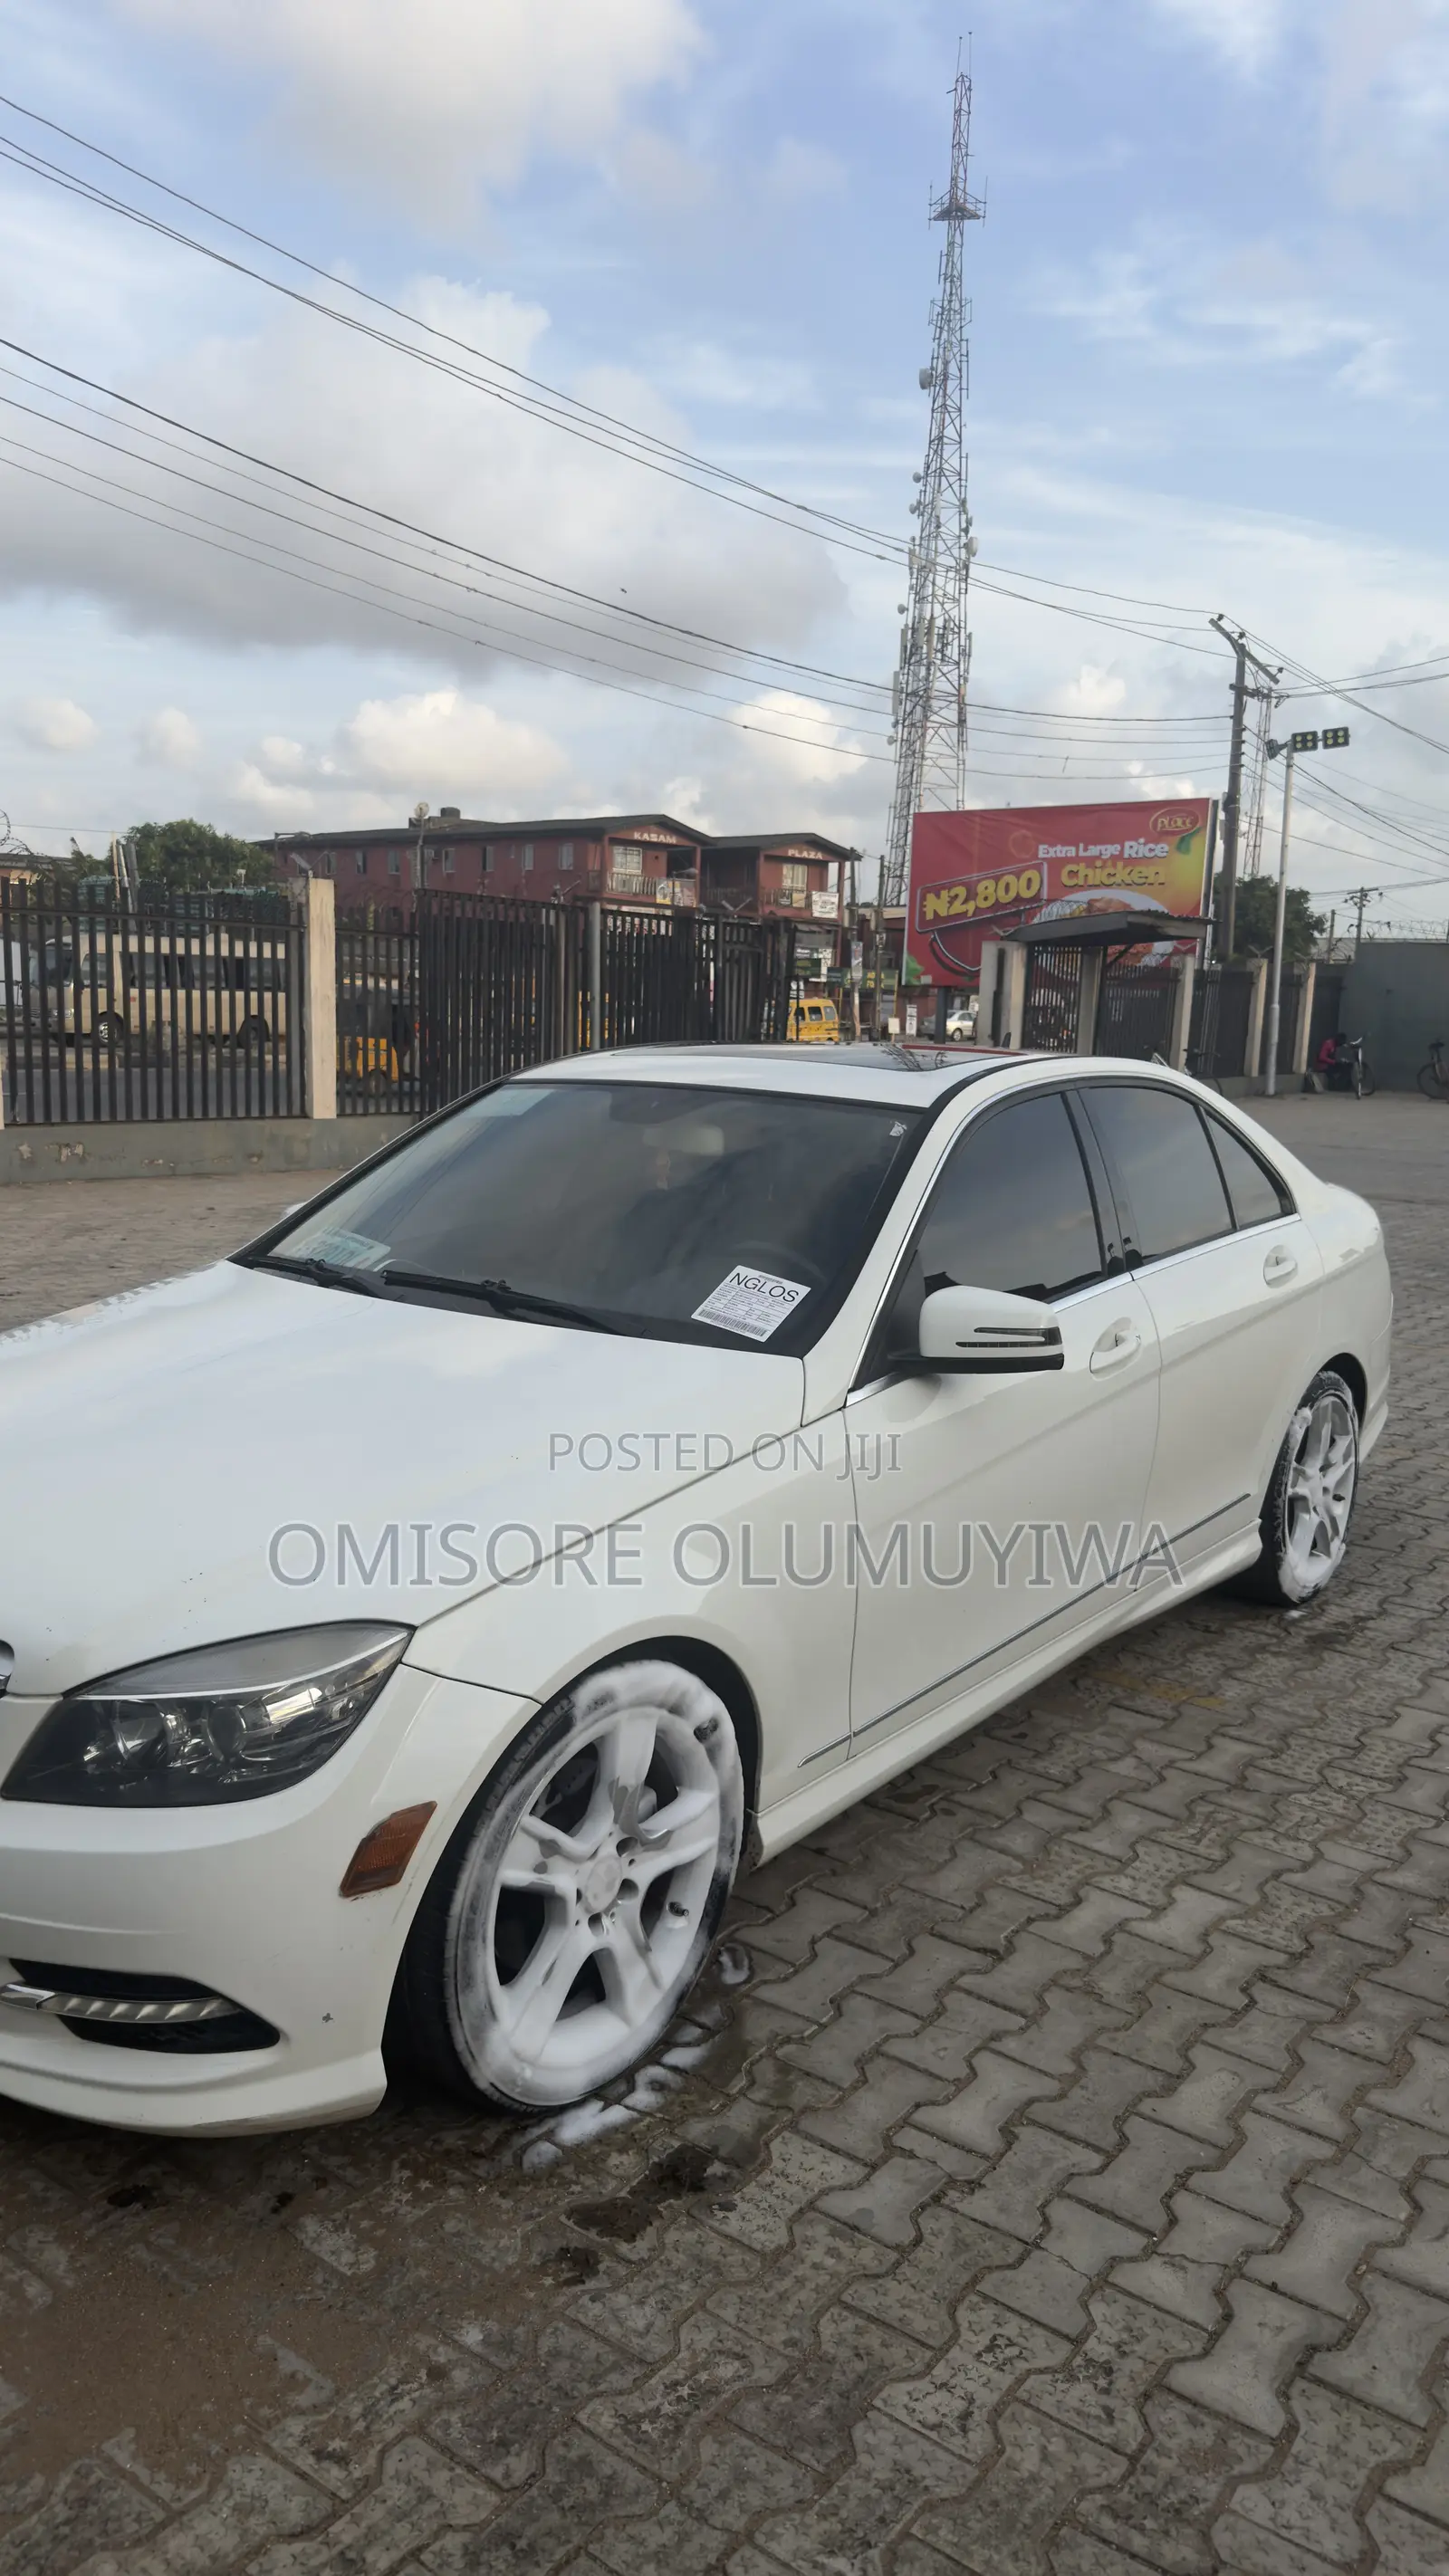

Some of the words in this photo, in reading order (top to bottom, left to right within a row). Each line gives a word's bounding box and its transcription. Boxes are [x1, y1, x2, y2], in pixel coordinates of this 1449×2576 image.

[634, 831, 677, 845] KASAM
[1038, 843, 1076, 858] Extra
[1079, 842, 1120, 859] Large
[1124, 838, 1169, 859] Rice
[788, 848, 823, 860] PLAZA
[1060, 861, 1166, 887] Chicken
[730, 1272, 799, 1302] NGLOS
